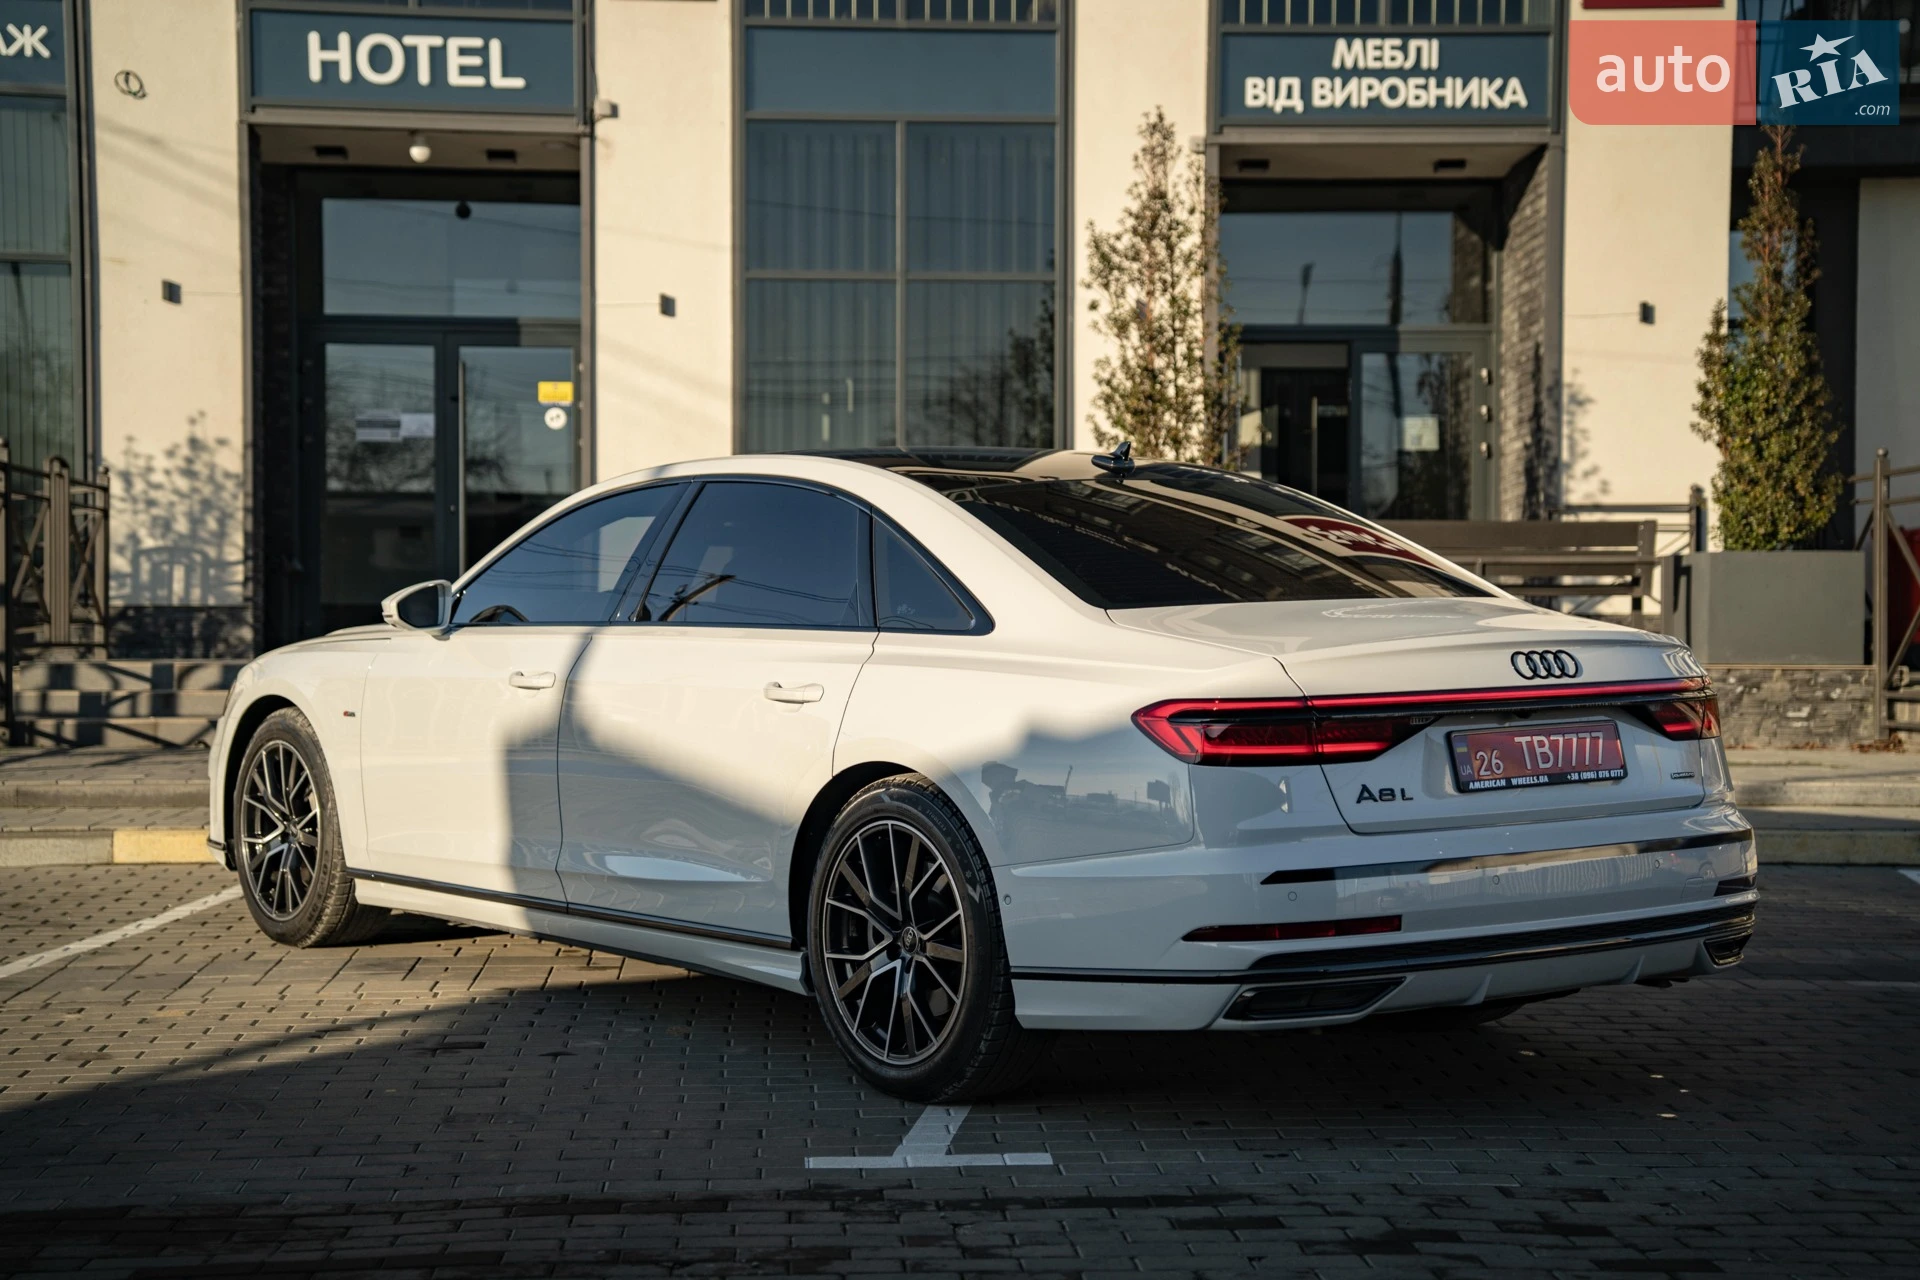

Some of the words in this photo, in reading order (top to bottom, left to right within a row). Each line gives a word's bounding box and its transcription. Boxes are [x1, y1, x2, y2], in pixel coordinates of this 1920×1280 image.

[0, 22, 52, 59] Ж
[1331, 37, 1440, 71] МЕБЛІ
[306, 29, 527, 90] HOTEL
[1244, 75, 1305, 114] ВІД
[1311, 75, 1529, 110] ВИРОБНИКА
[1460, 764, 1473, 776] UA
[1475, 749, 1504, 777] 26
[1514, 731, 1603, 770] TB7777
[1469, 779, 1506, 790] AMERICAN
[1511, 774, 1549, 786] WHEELS.UA
